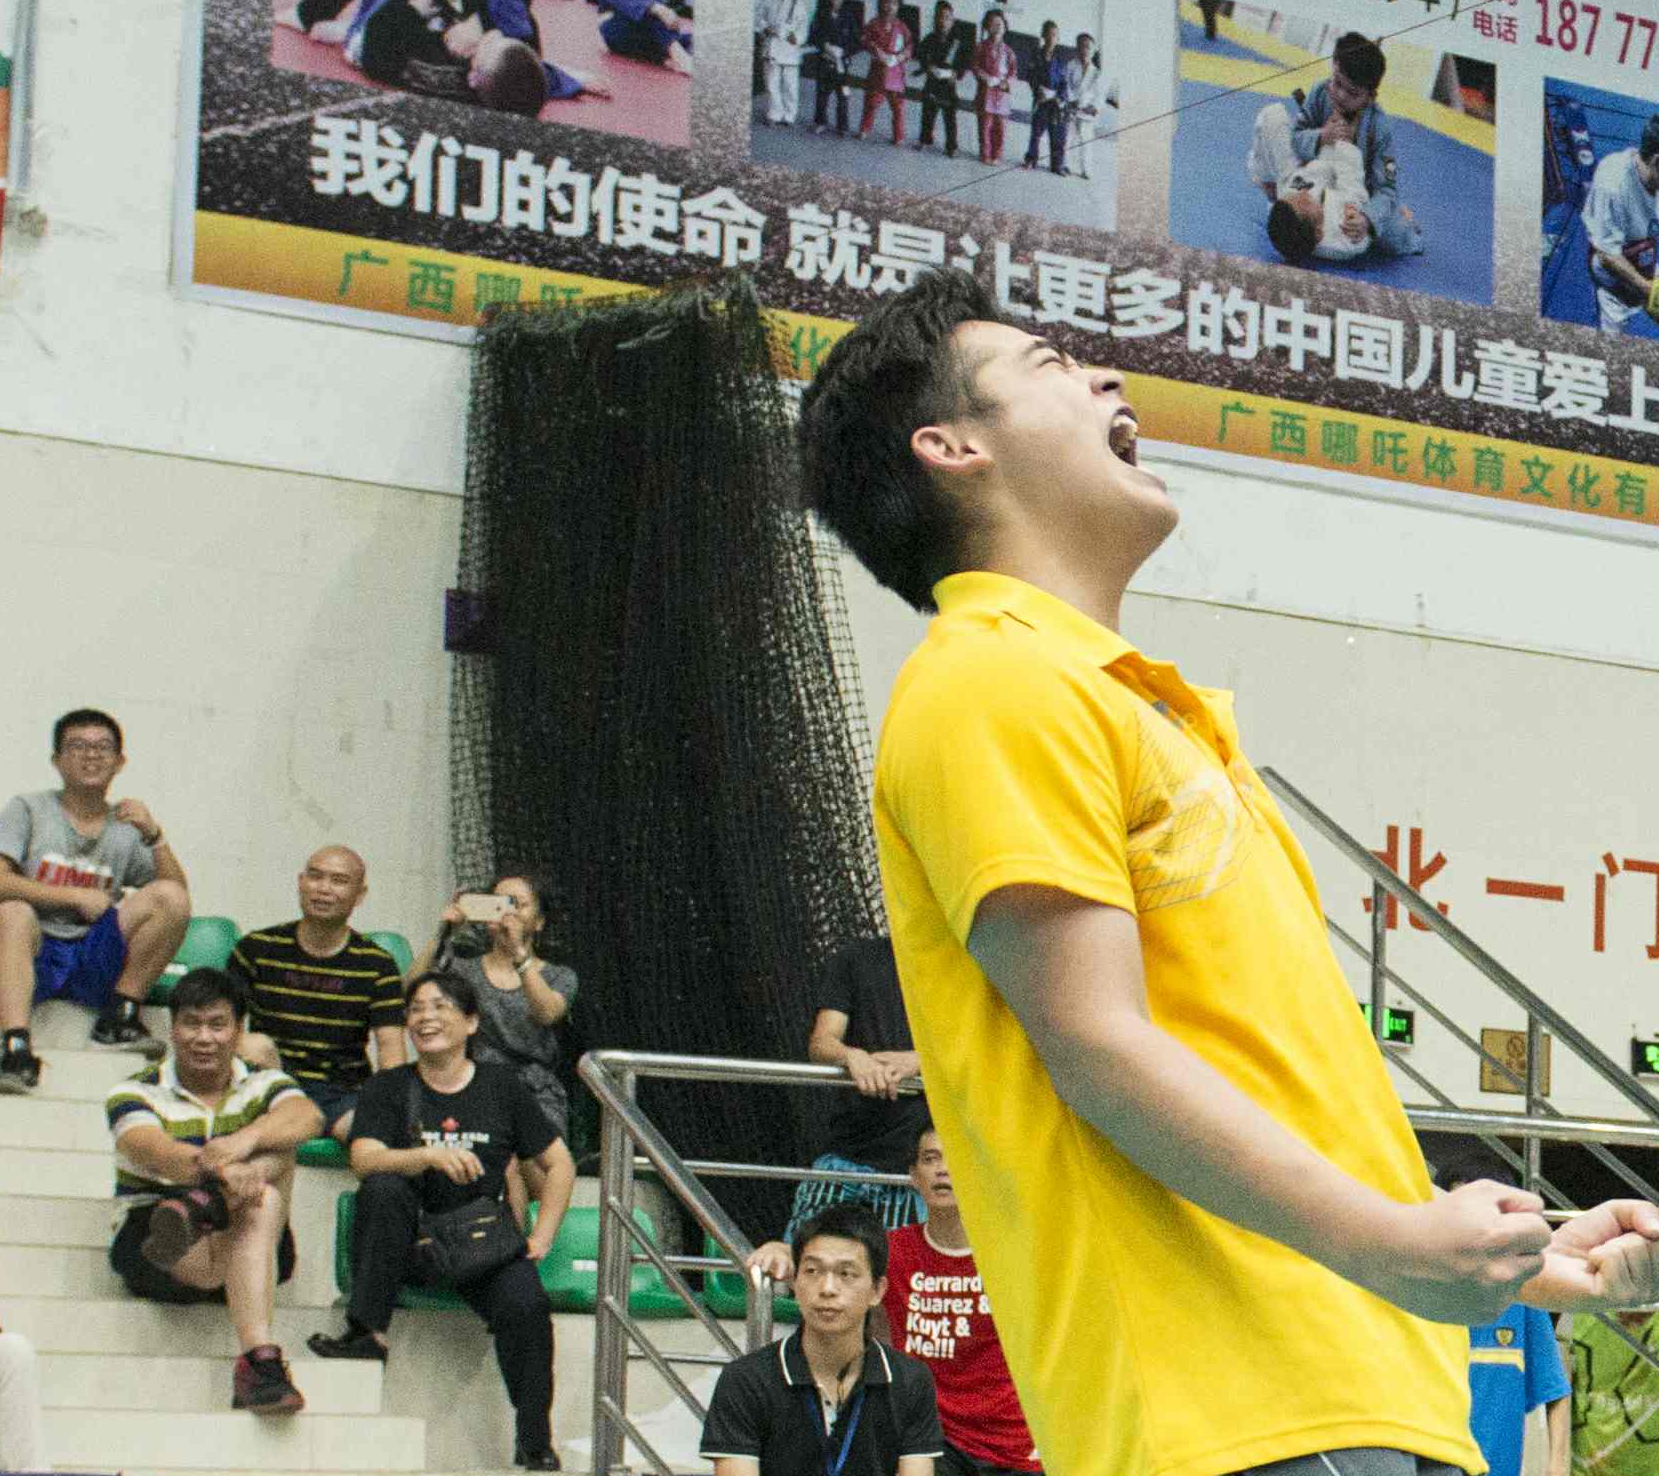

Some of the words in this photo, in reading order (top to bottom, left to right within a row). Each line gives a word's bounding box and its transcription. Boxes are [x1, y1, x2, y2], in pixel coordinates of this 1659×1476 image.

[1472, 9, 1519, 45] 电话
[312, 116, 766, 267] 我们的使命
[909, 1271, 982, 1293] Gerrard
[908, 1293, 974, 1314] Suarez
[906, 1311, 951, 1340] Kuyt
[955, 1316, 971, 1337] &
[905, 1334, 956, 1359] Me!!!
